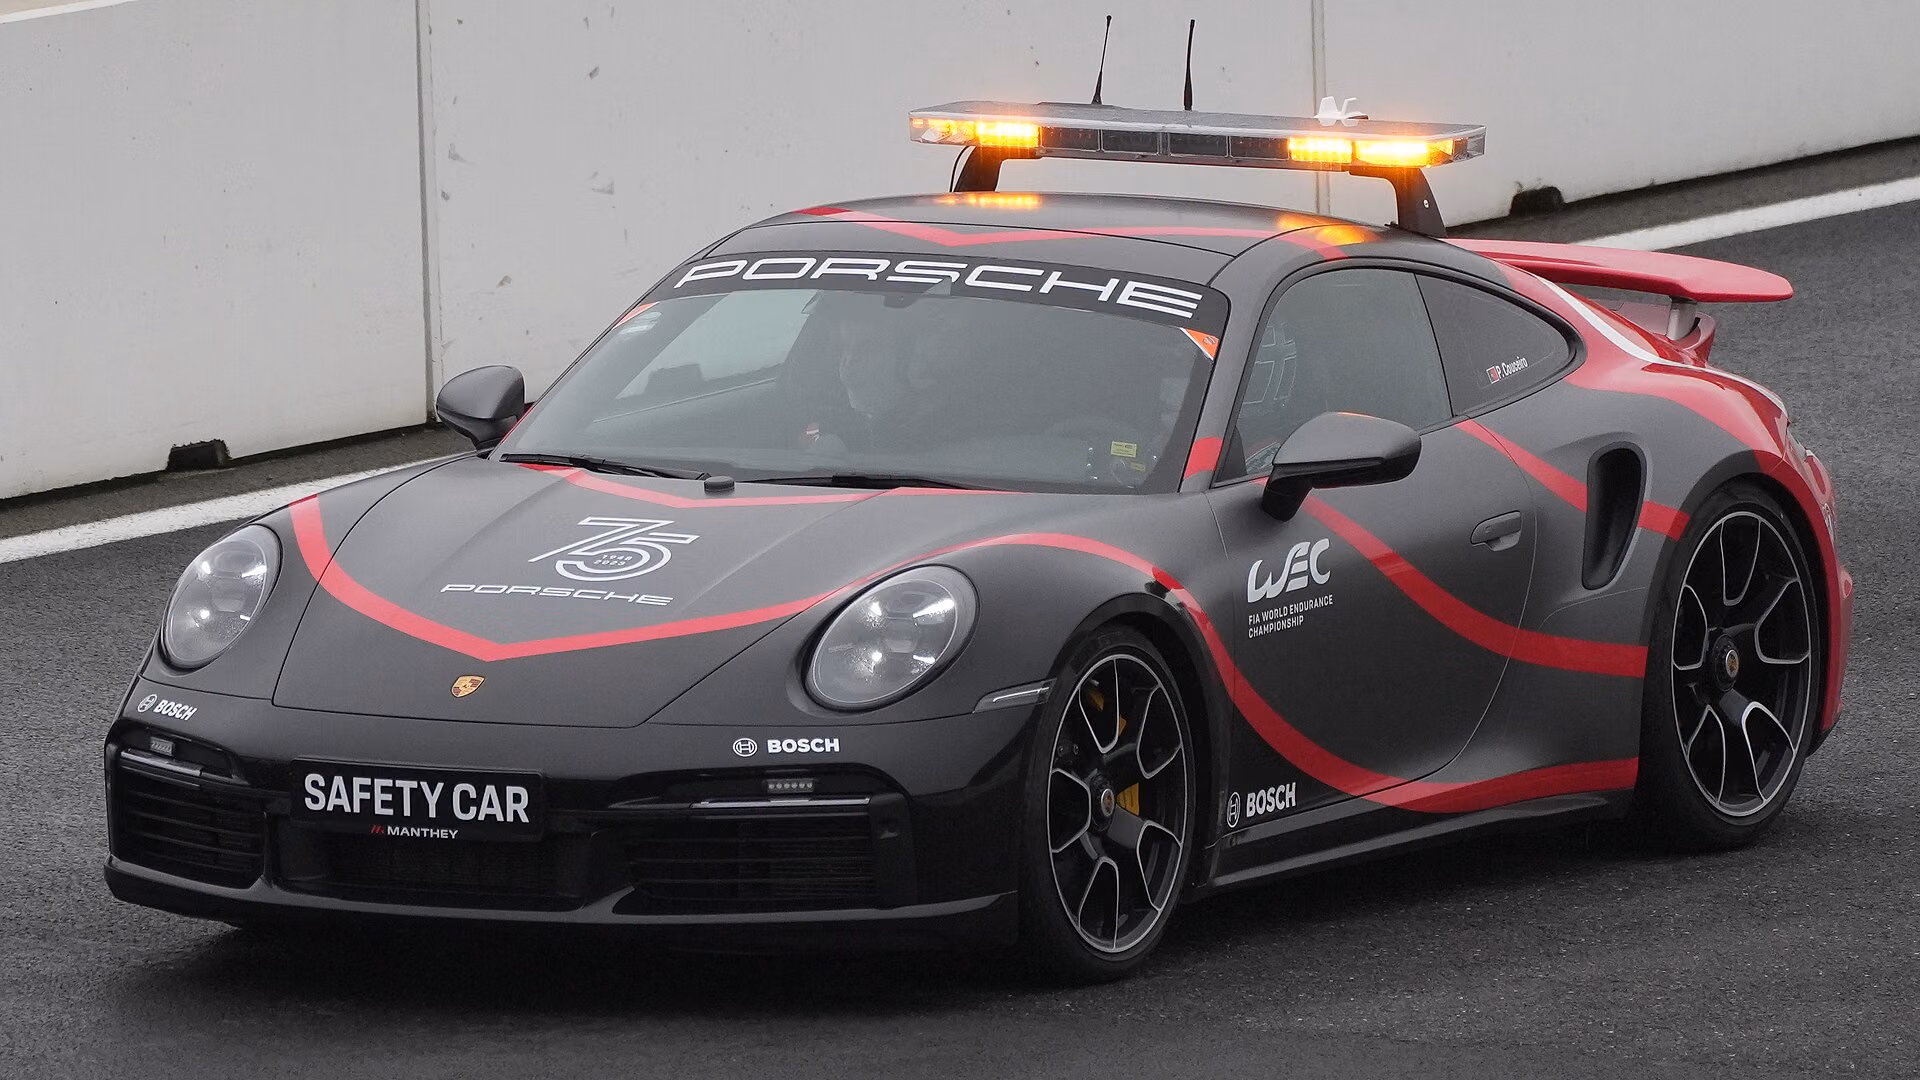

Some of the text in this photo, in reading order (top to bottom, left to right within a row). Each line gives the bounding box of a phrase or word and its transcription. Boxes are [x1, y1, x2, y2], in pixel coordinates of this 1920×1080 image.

[674, 257, 1202, 319] PORSCHE
[527, 516, 700, 582] 75
[1247, 538, 1331, 603] WEC
[440, 584, 674, 606] PORSCHE
[1248, 594, 1333, 625] FIA WORLD ENDURANCE
[1248, 615, 1304, 639] CHAMPIONSHIP
[153, 699, 198, 721] BOSCH
[767, 738, 840, 753] BOSCH
[304, 773, 530, 823] SAFETY CAR
[1246, 782, 1296, 818] BOSCH
[387, 826, 459, 839] MANTHEY
